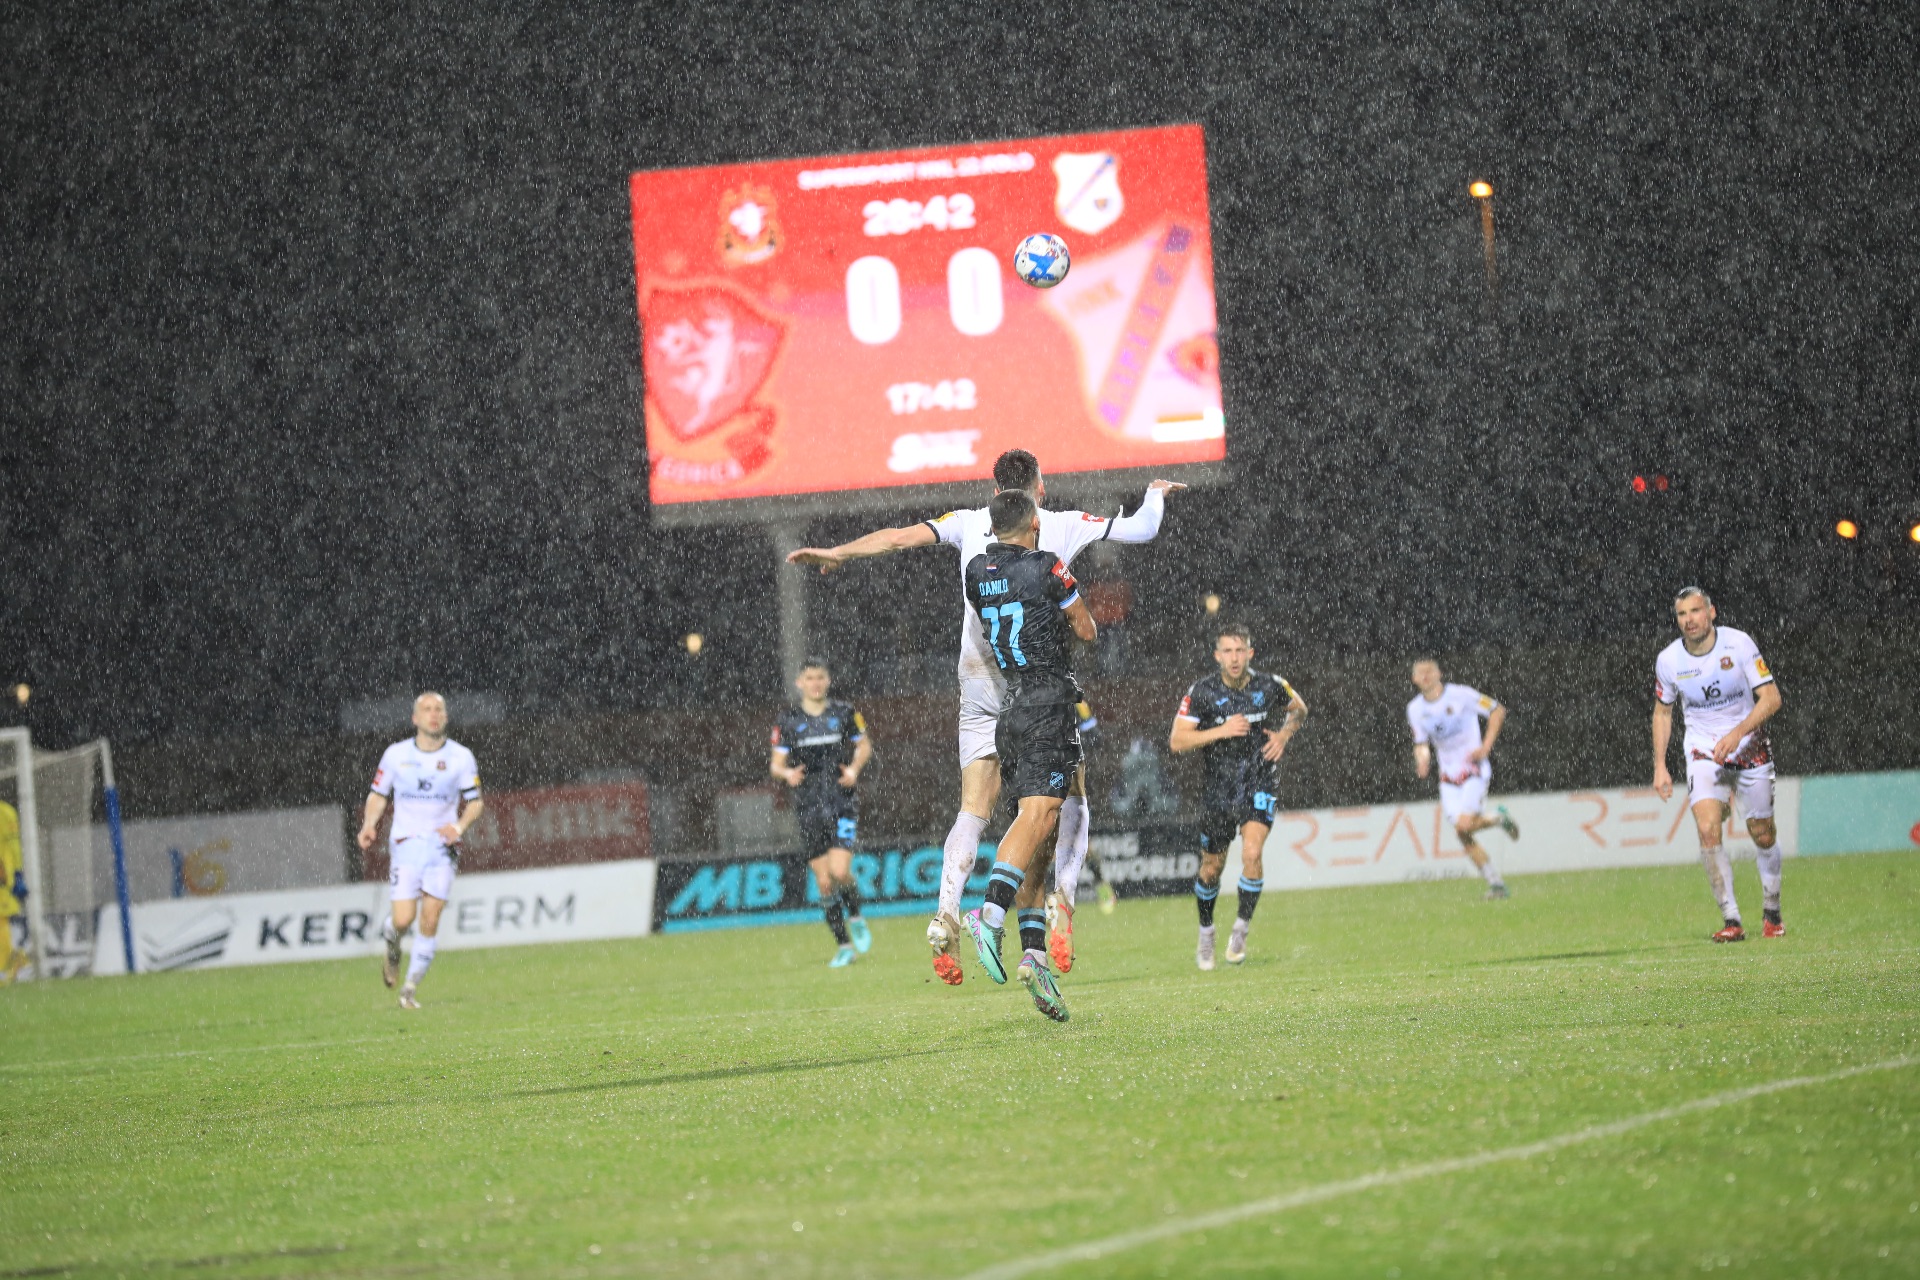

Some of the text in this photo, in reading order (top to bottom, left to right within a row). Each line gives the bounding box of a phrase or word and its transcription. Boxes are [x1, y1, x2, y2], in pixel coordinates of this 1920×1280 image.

[846, 255, 902, 342] 0
[948, 246, 1004, 337] 0
[885, 378, 978, 415] 17:42
[979, 578, 1009, 597] DANILO
[981, 601, 1028, 669] 77
[1281, 804, 1468, 868] REAL
[667, 861, 785, 913] MB
[259, 893, 576, 948] KERERM
